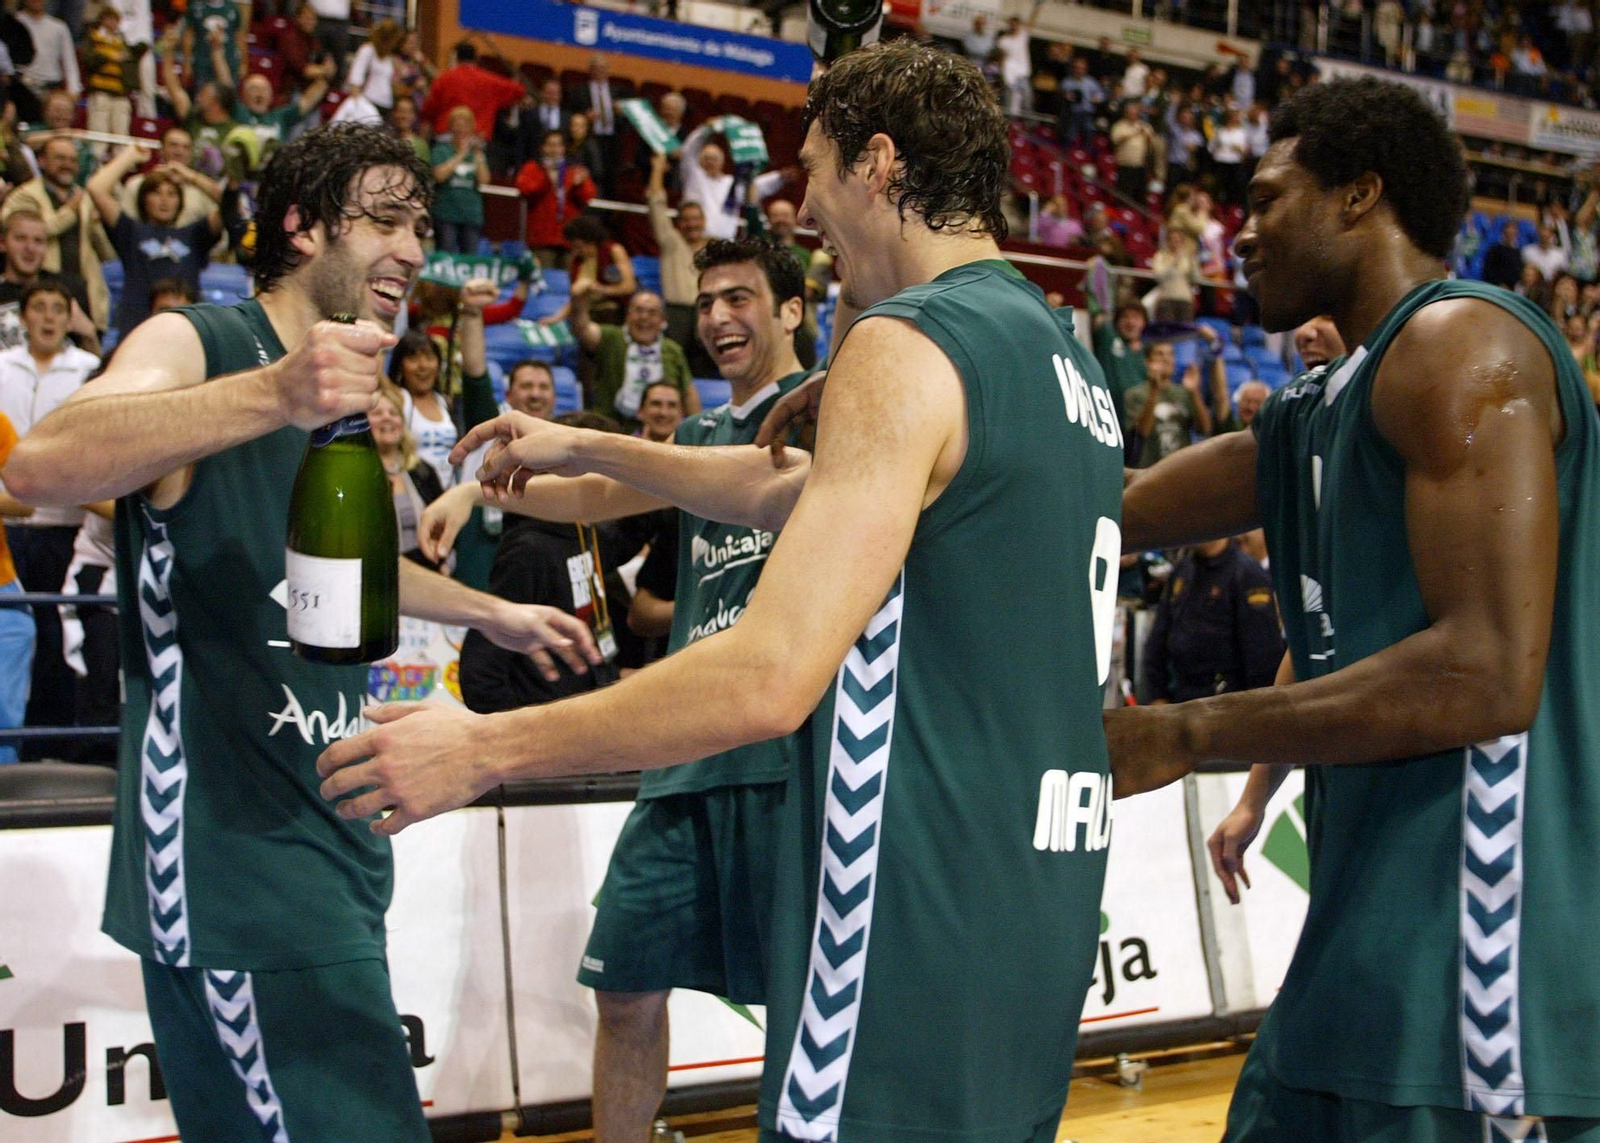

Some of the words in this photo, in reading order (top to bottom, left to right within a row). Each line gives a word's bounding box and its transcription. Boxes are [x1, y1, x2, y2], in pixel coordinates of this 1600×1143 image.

[704, 528, 773, 568] Unicaja
[268, 682, 368, 746] Andal
[1092, 911, 1158, 1006] ja
